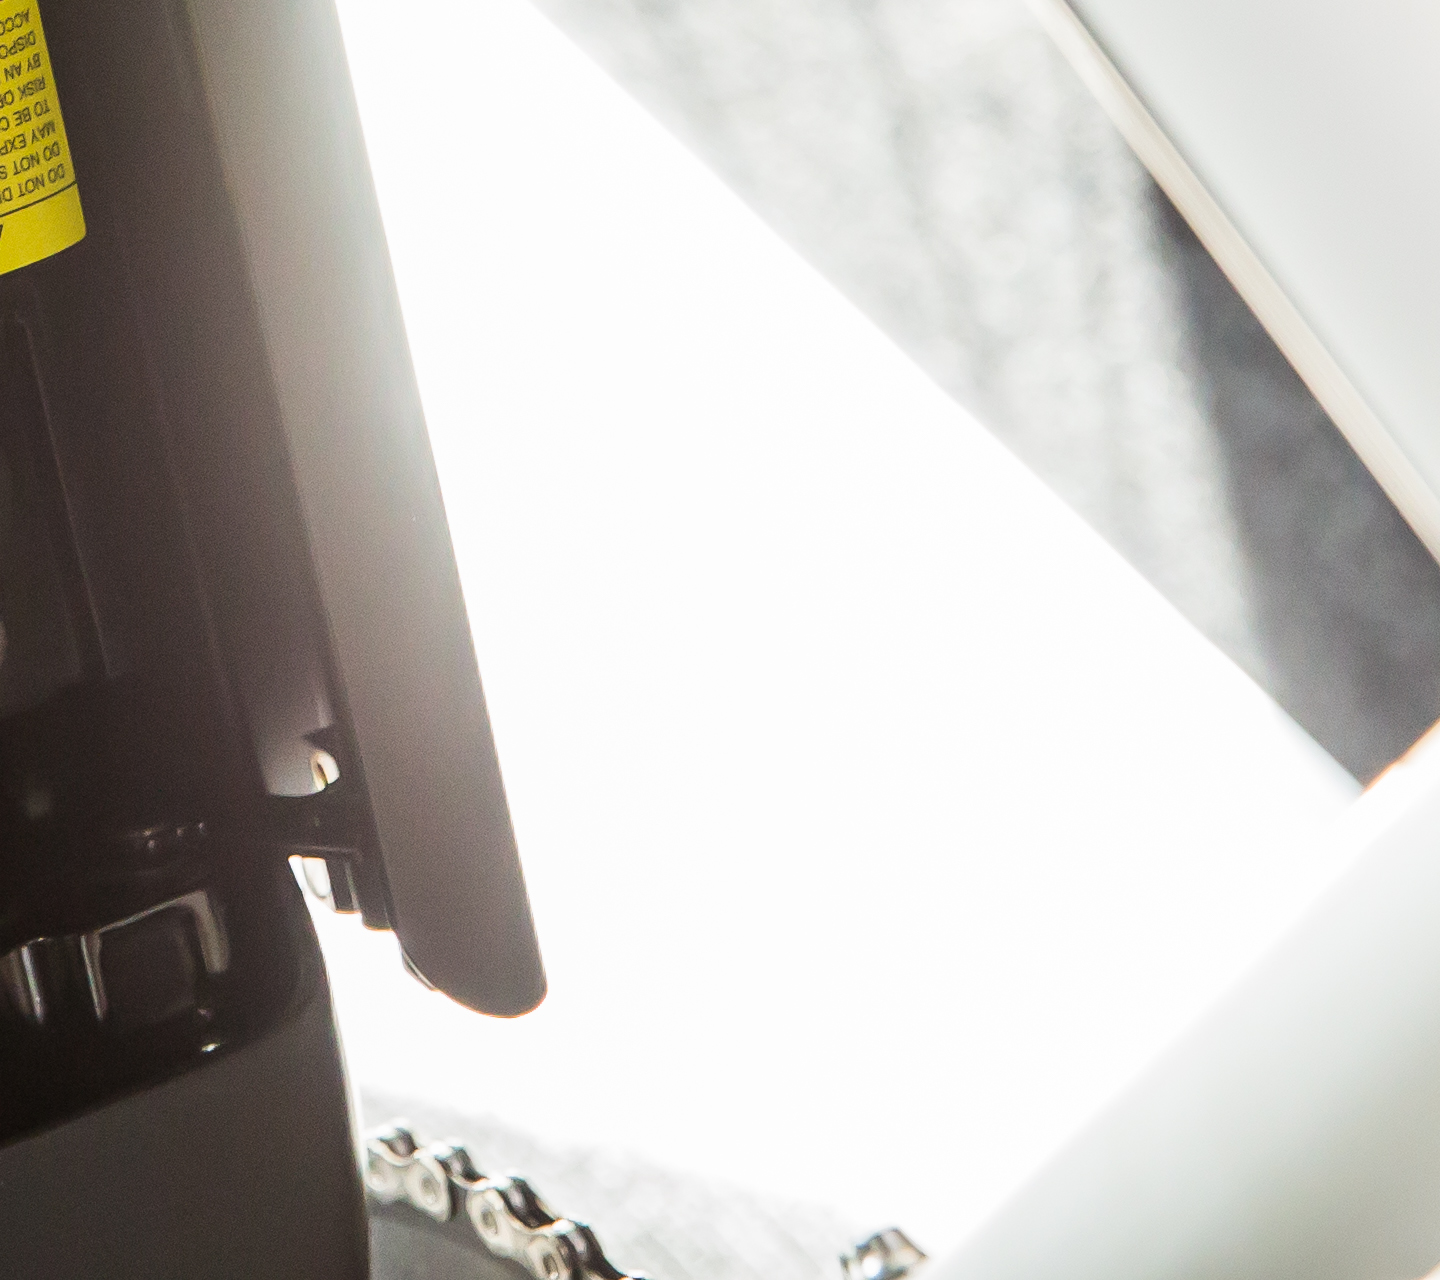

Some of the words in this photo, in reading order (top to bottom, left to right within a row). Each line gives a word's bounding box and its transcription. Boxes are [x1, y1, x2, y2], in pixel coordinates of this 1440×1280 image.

[3, 61, 22, 81] AN
[26, 52, 41, 72] BY
[16, 75, 46, 100] RISK
[12, 106, 32, 127] BE
[33, 98, 50, 117] TO
[30, 119, 55, 144] MAY
[42, 140, 60, 161] DO
[12, 151, 40, 176] NOT
[46, 162, 65, 183] DO
[17, 173, 45, 198] NOT
